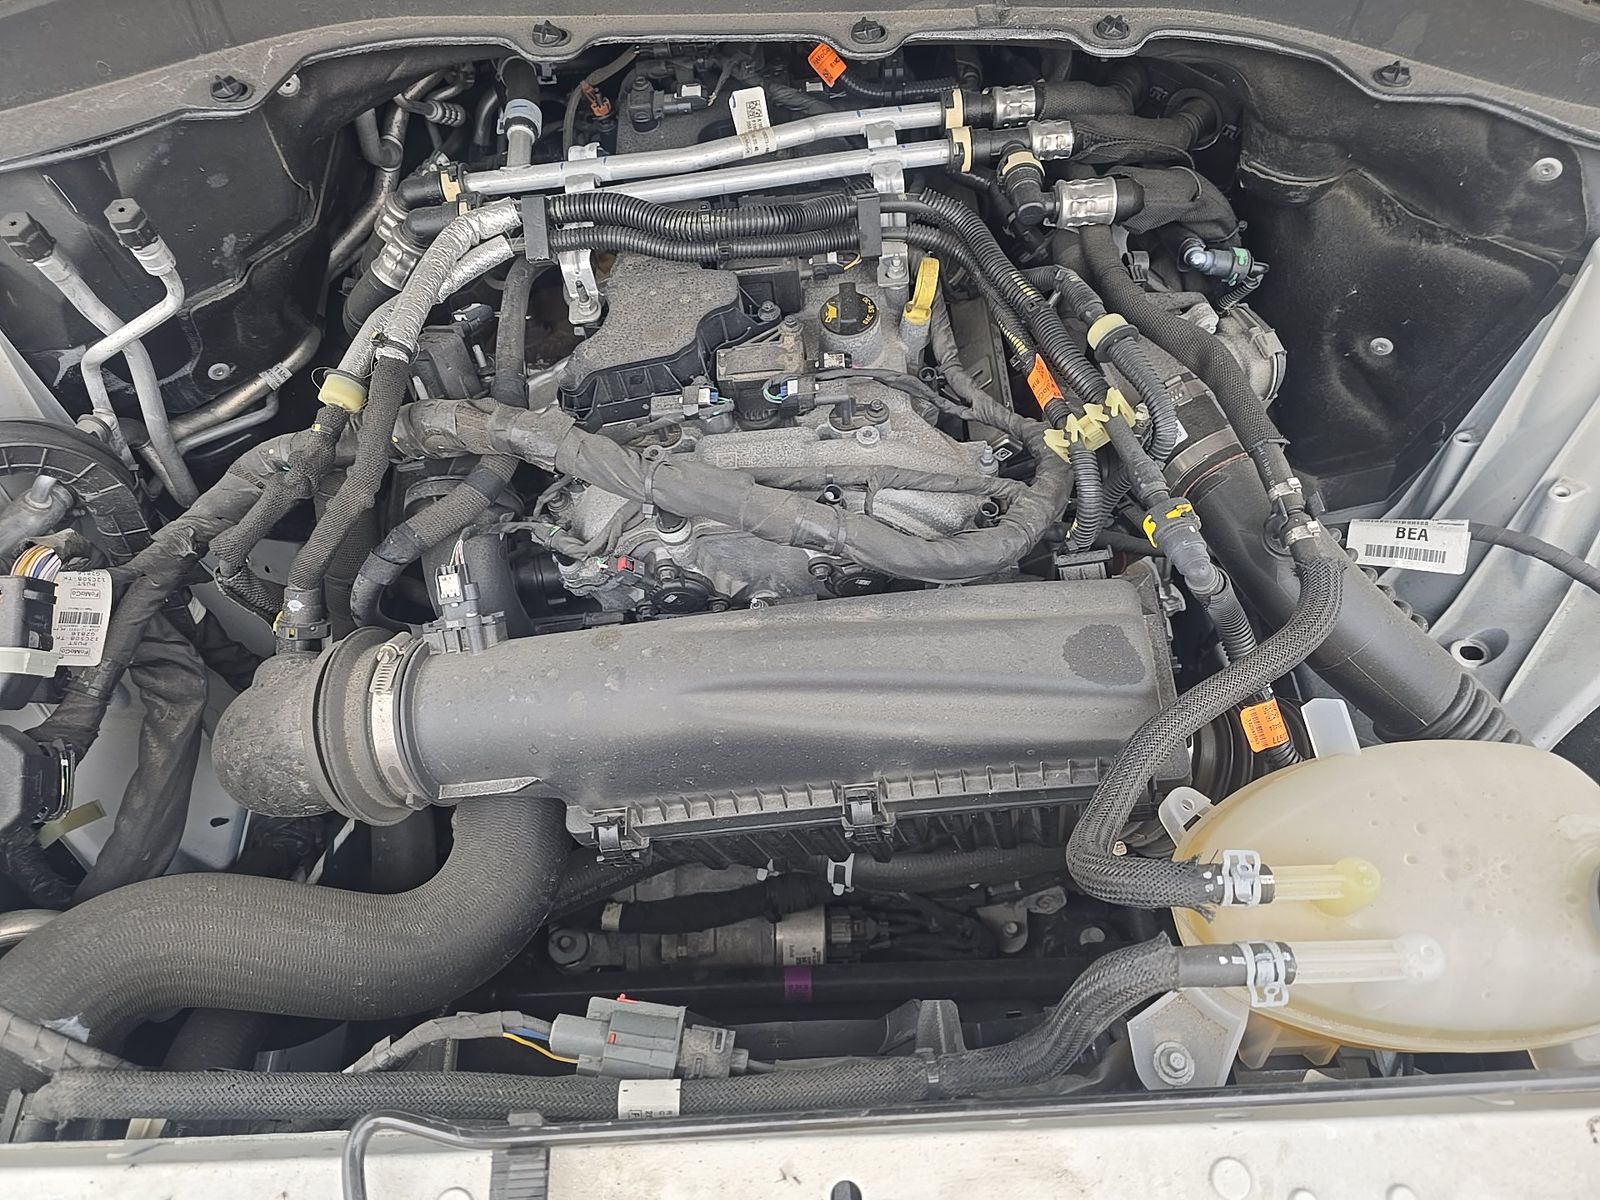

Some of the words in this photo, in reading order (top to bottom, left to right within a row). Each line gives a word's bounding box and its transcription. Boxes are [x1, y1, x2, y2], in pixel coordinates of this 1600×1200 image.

[1395, 526, 1429, 542] BEA
[70, 590, 100, 598] FoMoCo
[60, 648, 90, 656] FoMoCo
